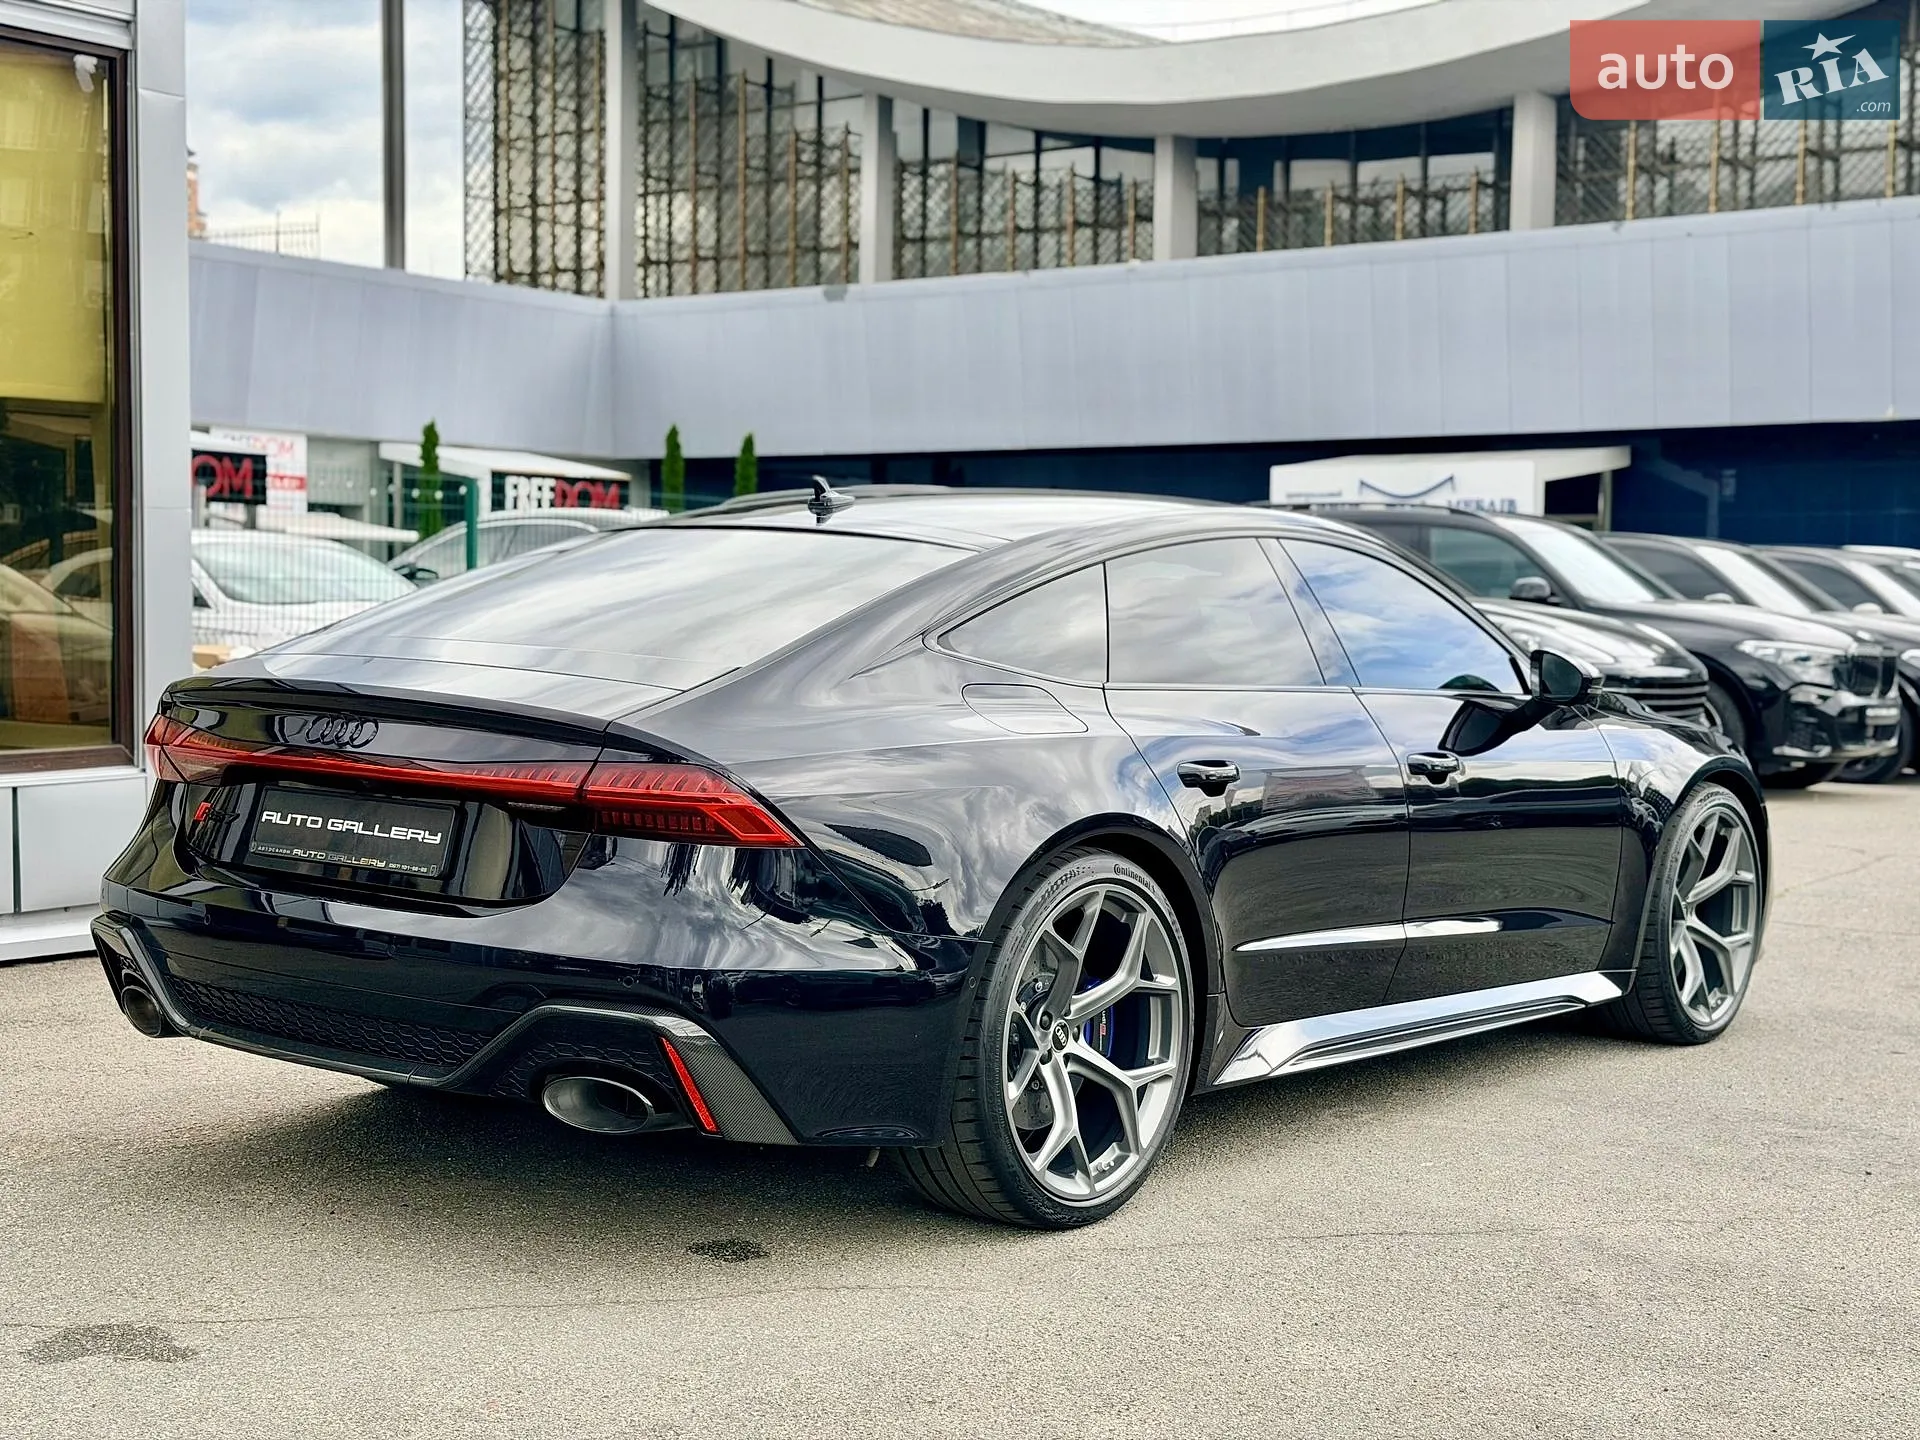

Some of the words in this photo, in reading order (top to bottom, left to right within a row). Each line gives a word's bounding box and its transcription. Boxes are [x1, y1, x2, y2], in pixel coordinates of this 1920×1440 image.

[504, 474, 620, 510] FREEDOM
[261, 811, 323, 829] AUTO
[327, 818, 443, 845] GALLERY
[292, 848, 326, 860] AUTO
[328, 853, 387, 869] GALLERY
